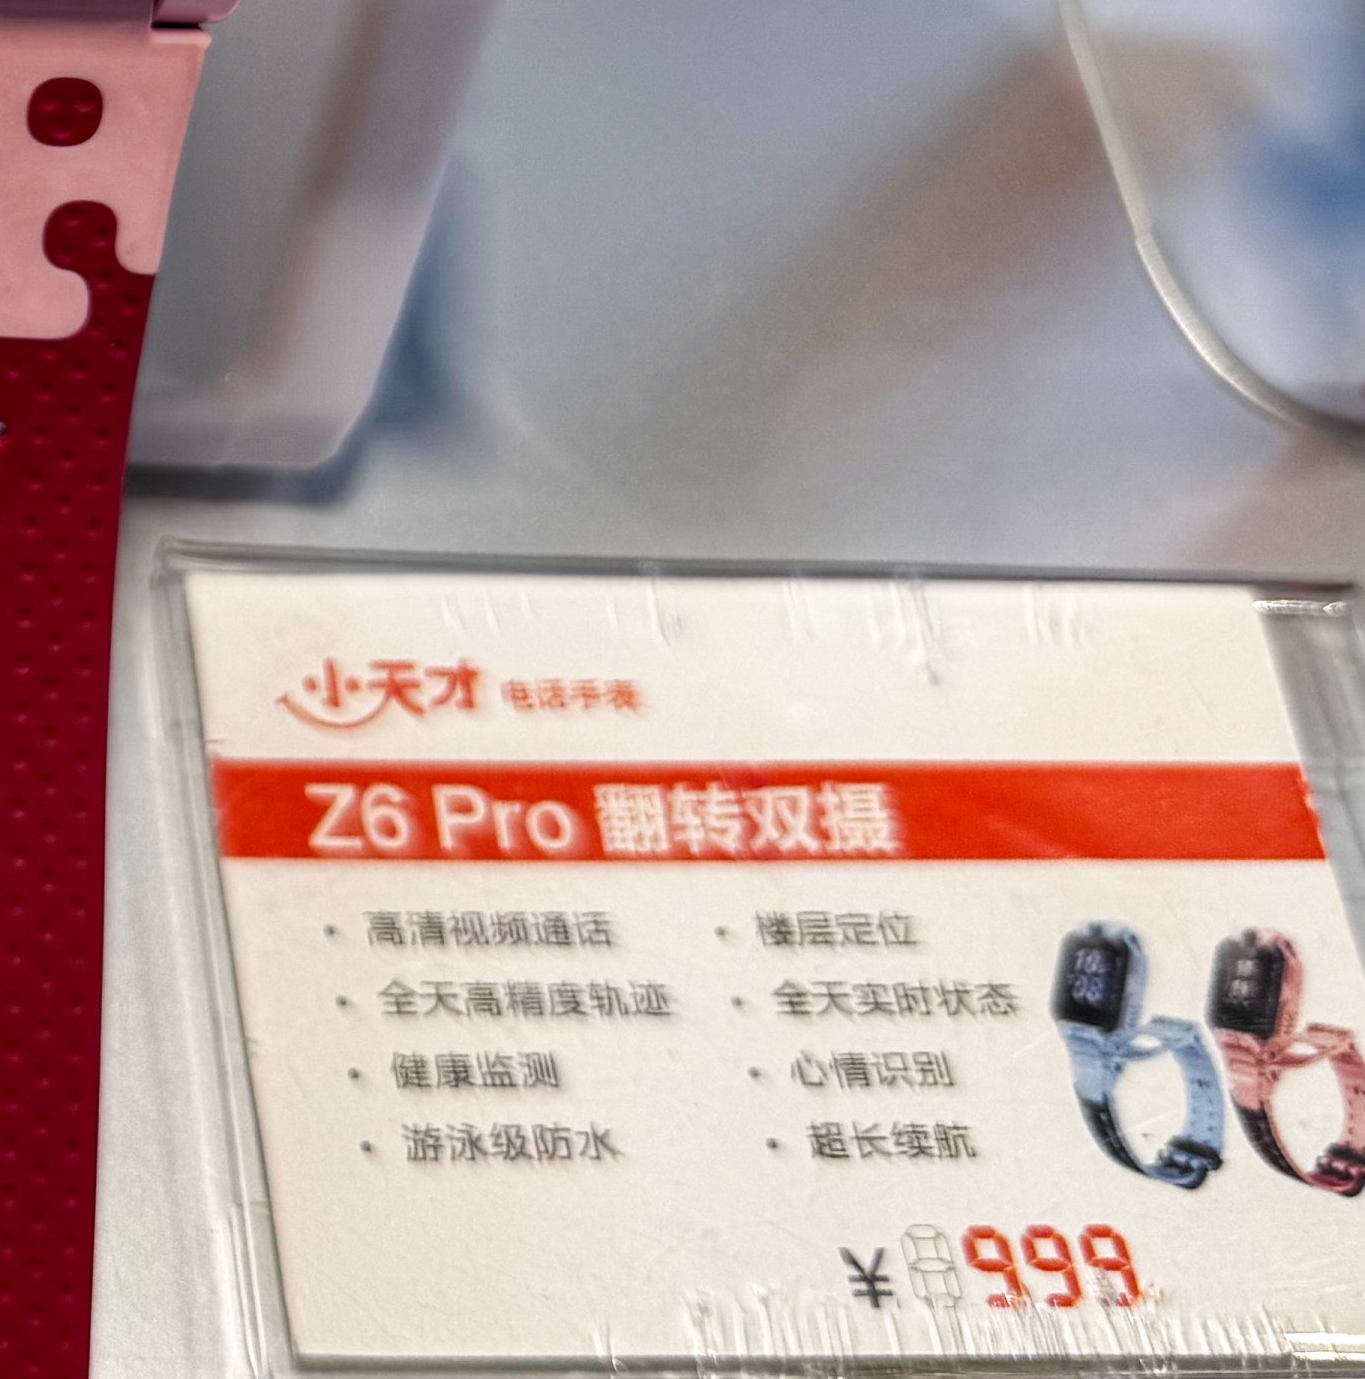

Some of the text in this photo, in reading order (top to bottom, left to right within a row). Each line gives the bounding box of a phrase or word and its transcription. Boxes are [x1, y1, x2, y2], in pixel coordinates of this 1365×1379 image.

[302, 658, 643, 717] 小天才 电话手表
[304, 780, 902, 857] Z6 Pro 翻转双摄
[364, 908, 616, 949] 高清视频通话
[754, 908, 920, 949] 楼层定位
[378, 978, 676, 1018] 全天高精度轨迹
[772, 978, 1024, 1018] 全天实时状态
[390, 1050, 562, 1090] 健康监测
[790, 1049, 955, 1089] 心情识别
[401, 1121, 623, 1163] 游泳级防水
[806, 1120, 978, 1160] 超长续航
[961, 1222, 1143, 1309] 999
